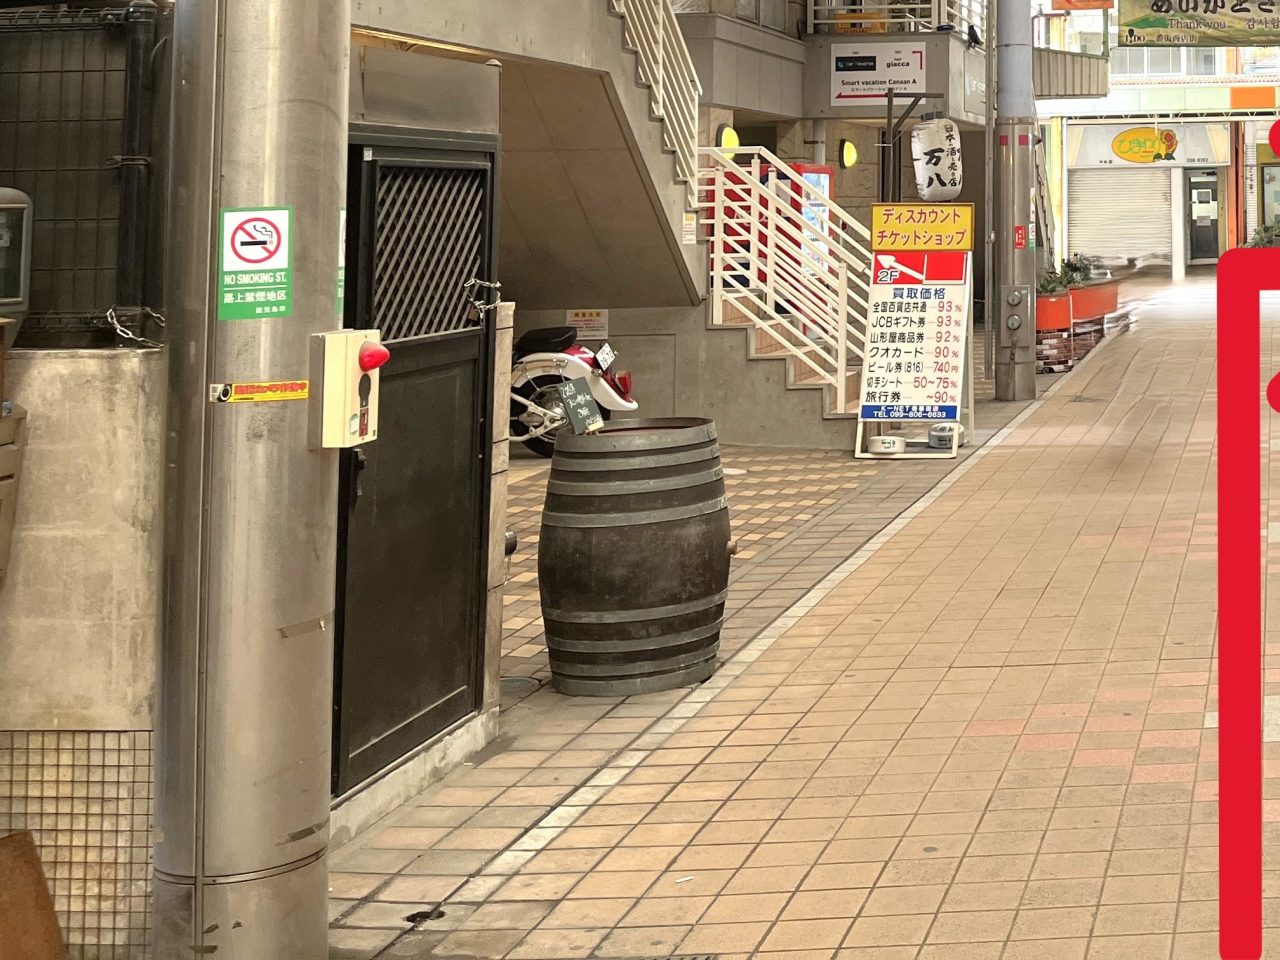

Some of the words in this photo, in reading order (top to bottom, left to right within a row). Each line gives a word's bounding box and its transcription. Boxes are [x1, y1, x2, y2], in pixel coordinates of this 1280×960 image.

[1168, 18, 1202, 29] Thank
[1206, 21, 1227, 30] you
[923, 147, 947, 188] 万八
[883, 208, 961, 224] ディスカウント
[877, 229, 967, 246] チケットショップ
[224, 274, 236, 285] NO
[237, 272, 274, 285] SMOKING
[275, 271, 287, 283] ST.
[878, 270, 899, 282] 2F
[224, 290, 287, 304] 路上禁煙地区
[893, 288, 946, 300] 買取価格
[872, 302, 927, 313] 全国百貨店共通
[872, 316, 926, 328] JCBギフト券
[870, 331, 925, 344] 山形屋商品券
[869, 346, 924, 359] クオカード
[868, 361, 924, 374] ビール券(816)
[933, 361, 958, 373] 740円
[866, 376, 903, 388] 切手シート
[865, 391, 901, 403] 旅行券
